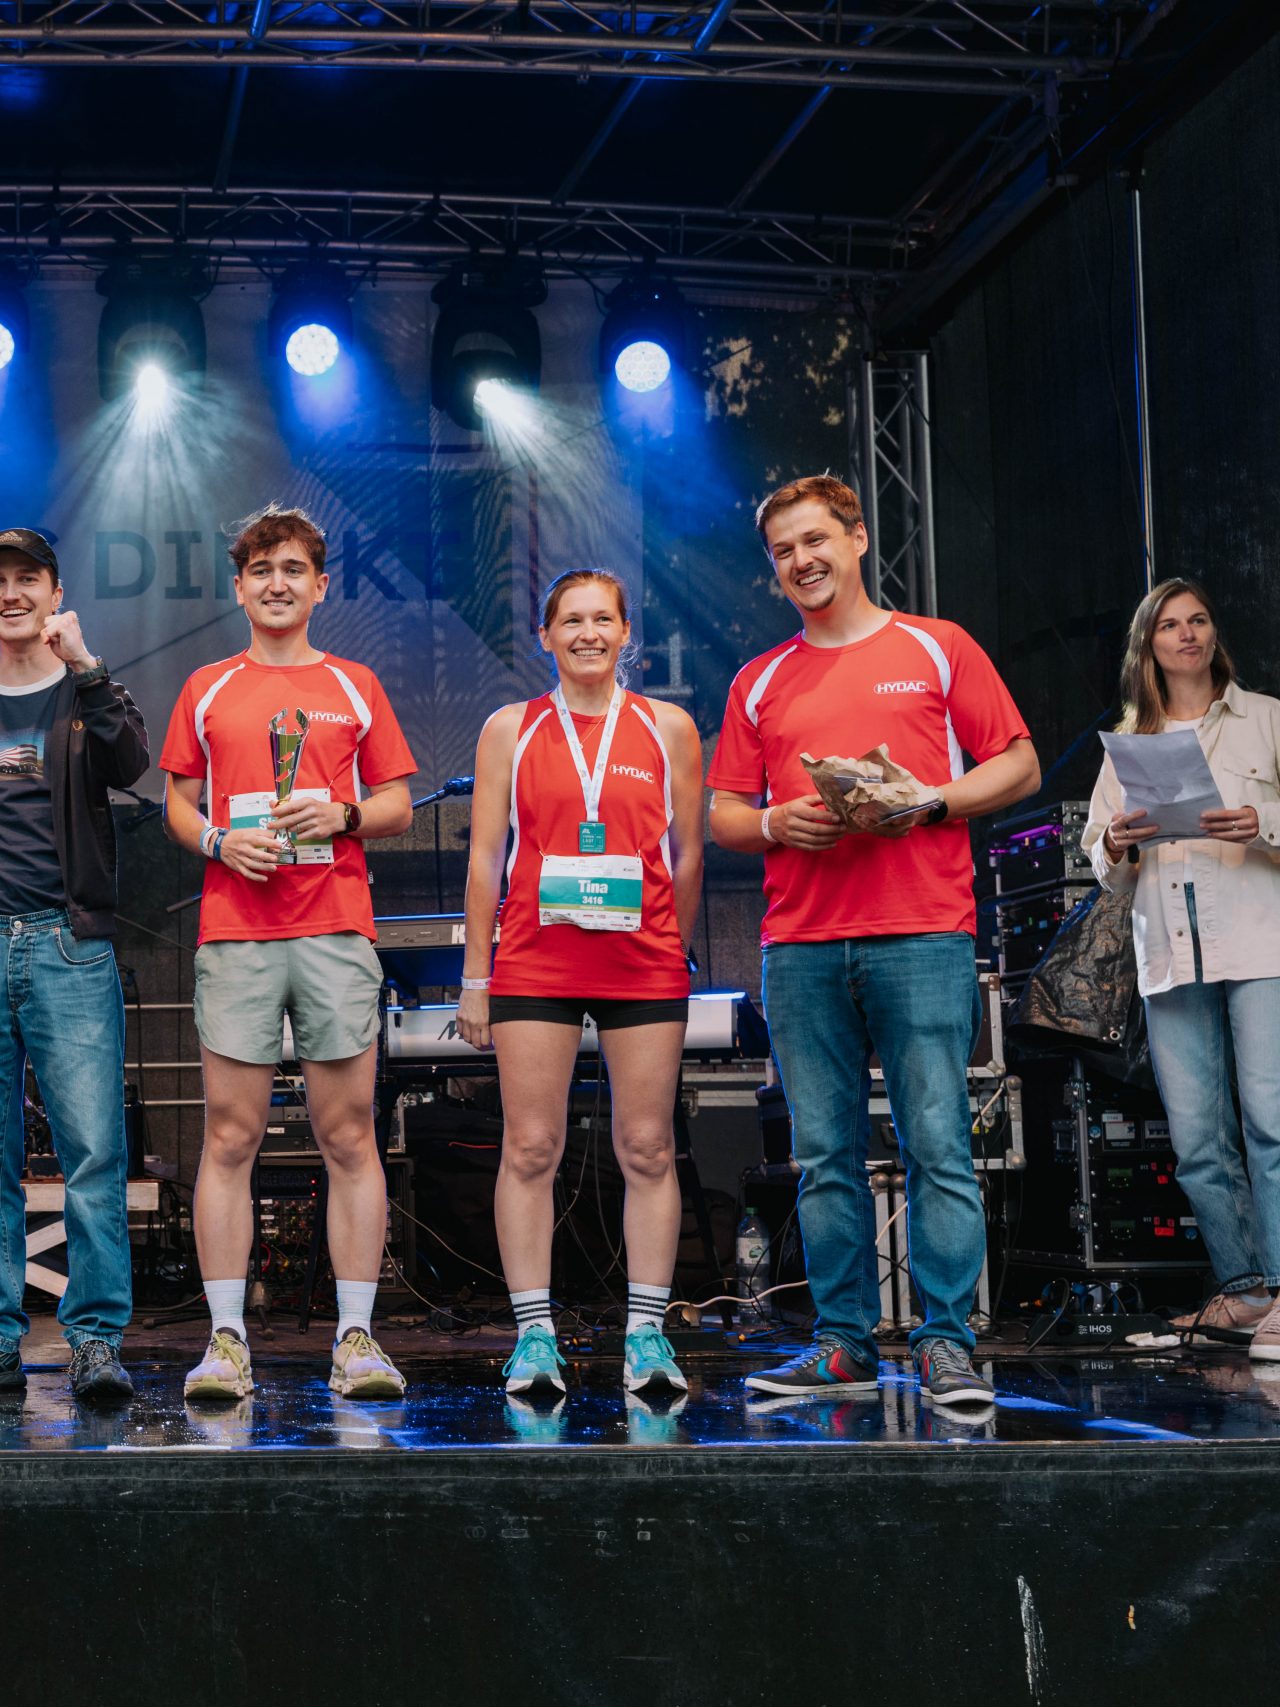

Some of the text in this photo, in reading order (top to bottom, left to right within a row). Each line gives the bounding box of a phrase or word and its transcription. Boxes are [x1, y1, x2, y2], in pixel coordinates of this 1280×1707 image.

[95, 530, 462, 600] DIKT
[877, 681, 926, 693] HYDAC
[308, 711, 353, 725] HYDAC
[612, 765, 653, 783] HYDAC
[578, 880, 608, 894] Tina
